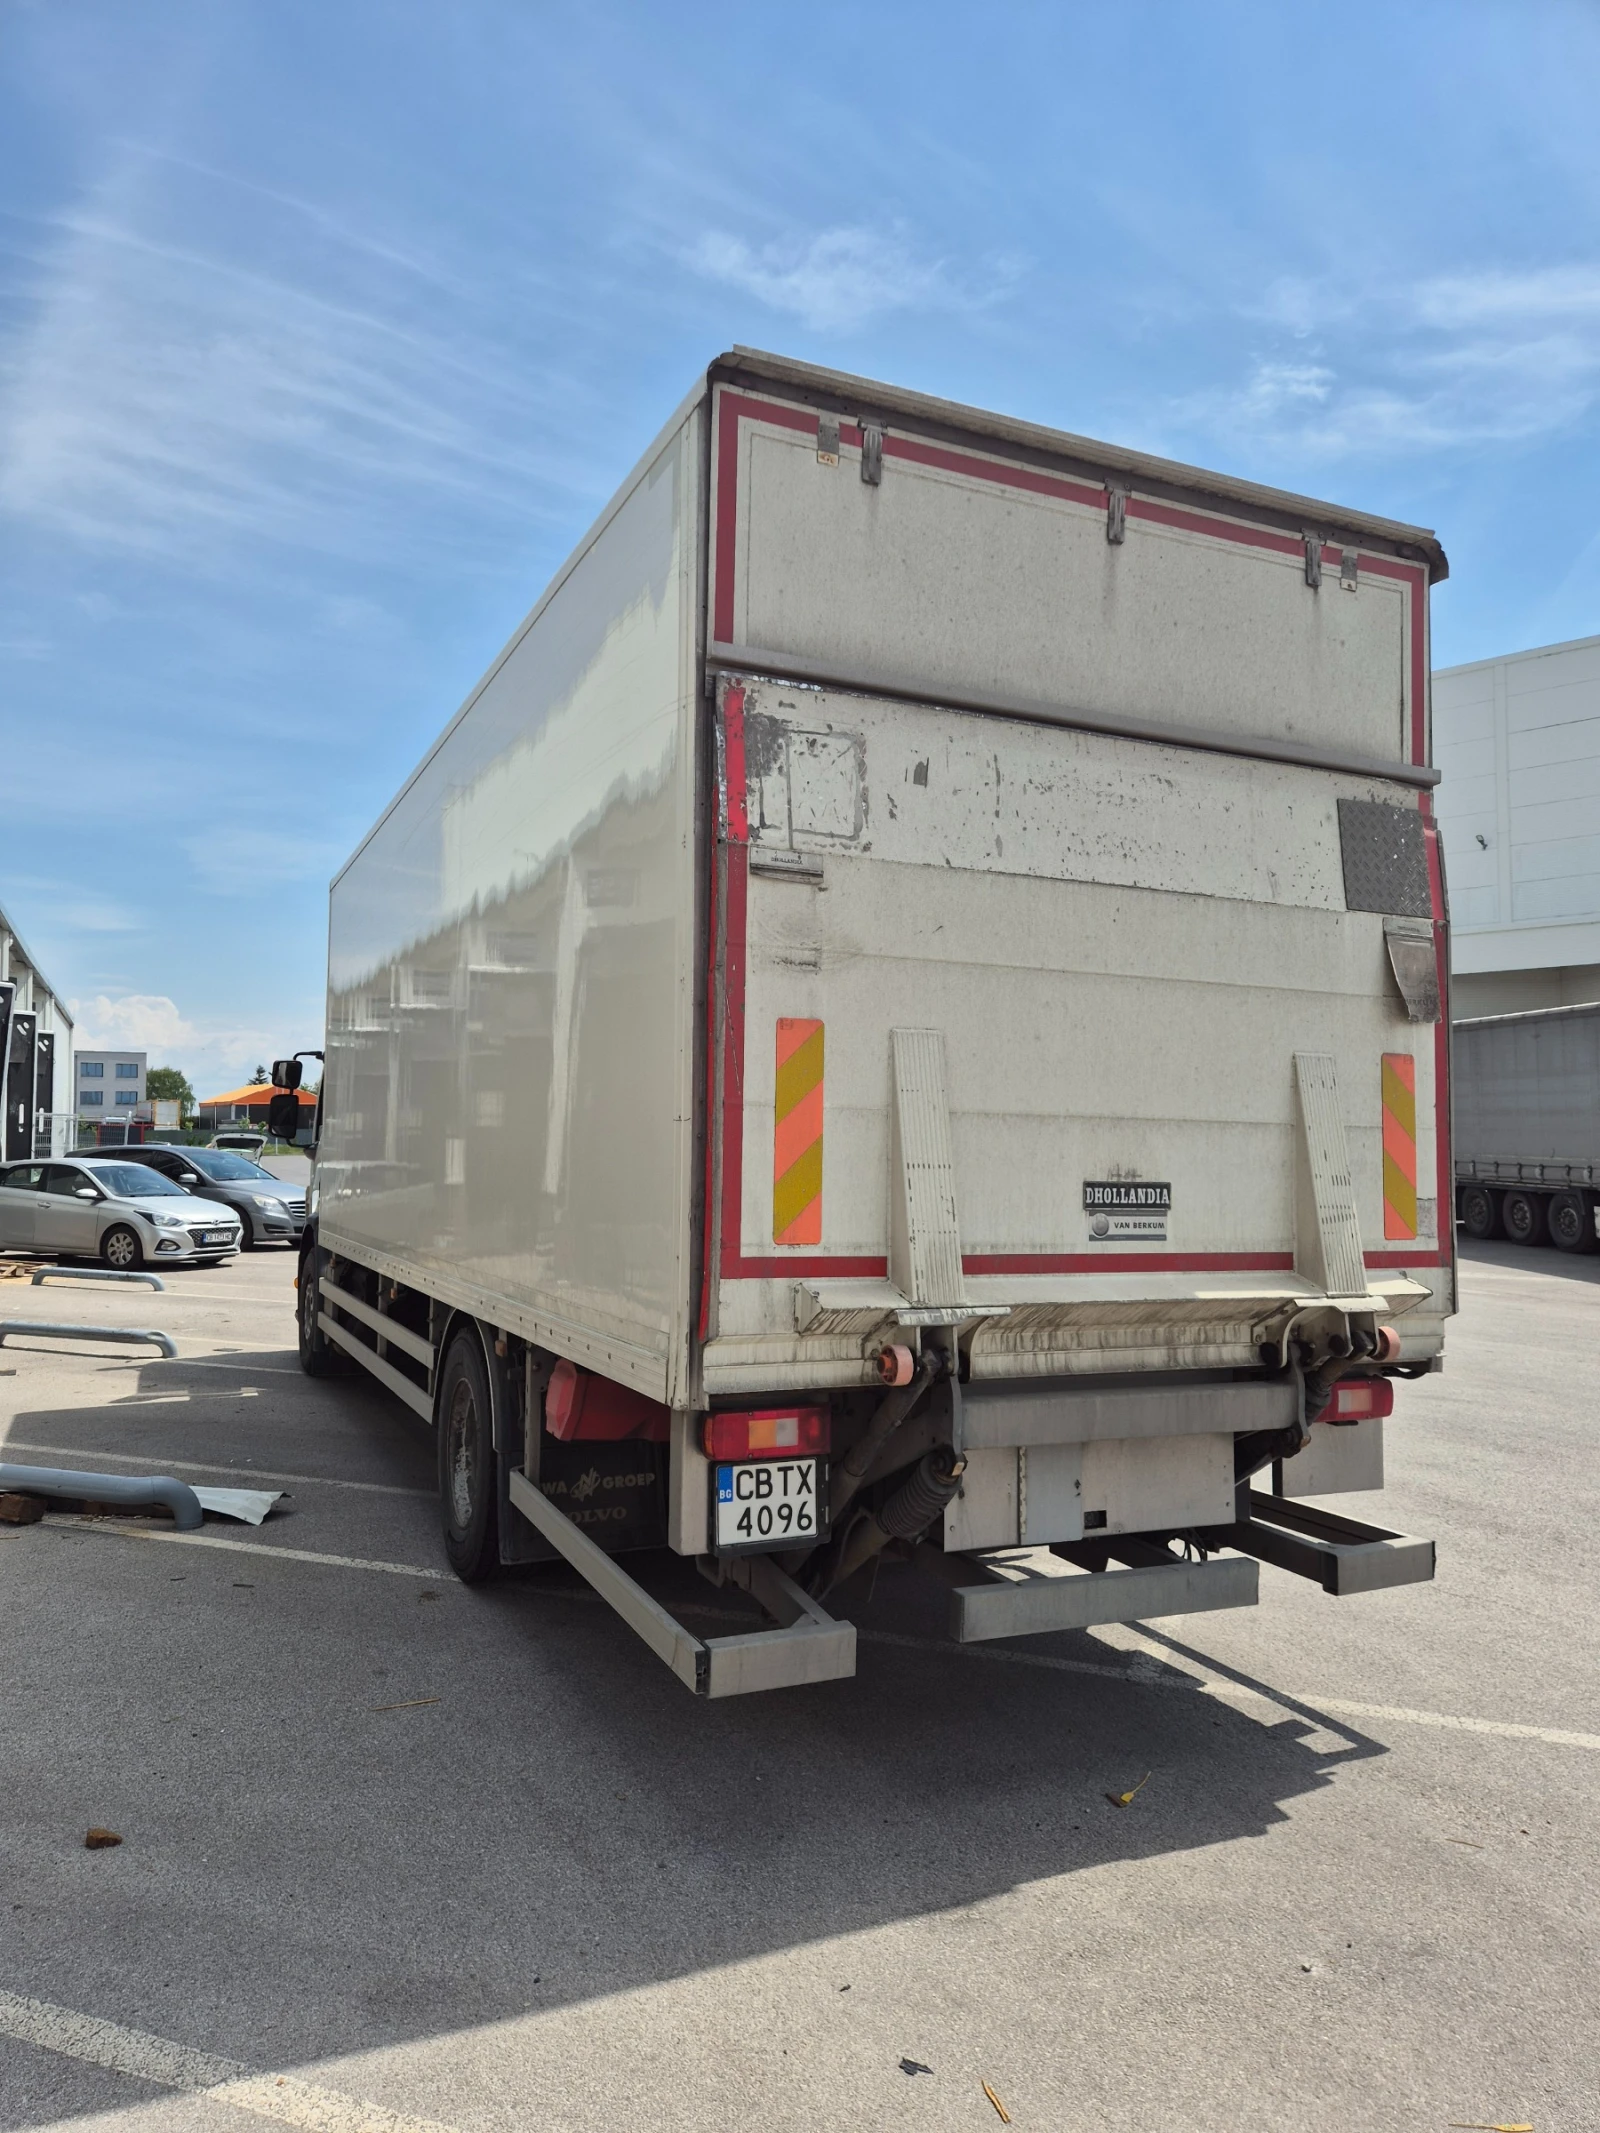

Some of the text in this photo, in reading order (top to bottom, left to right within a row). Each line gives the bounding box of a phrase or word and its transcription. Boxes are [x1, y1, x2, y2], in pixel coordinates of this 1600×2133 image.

[1085, 1187, 1170, 1204] DHOLLANDIA
[540, 1480, 568, 1495] WA
[602, 1473, 655, 1489] GROEP
[719, 1489, 732, 1499] BG
[567, 1506, 628, 1524] OLVO
[736, 1501, 813, 1537] 4096
